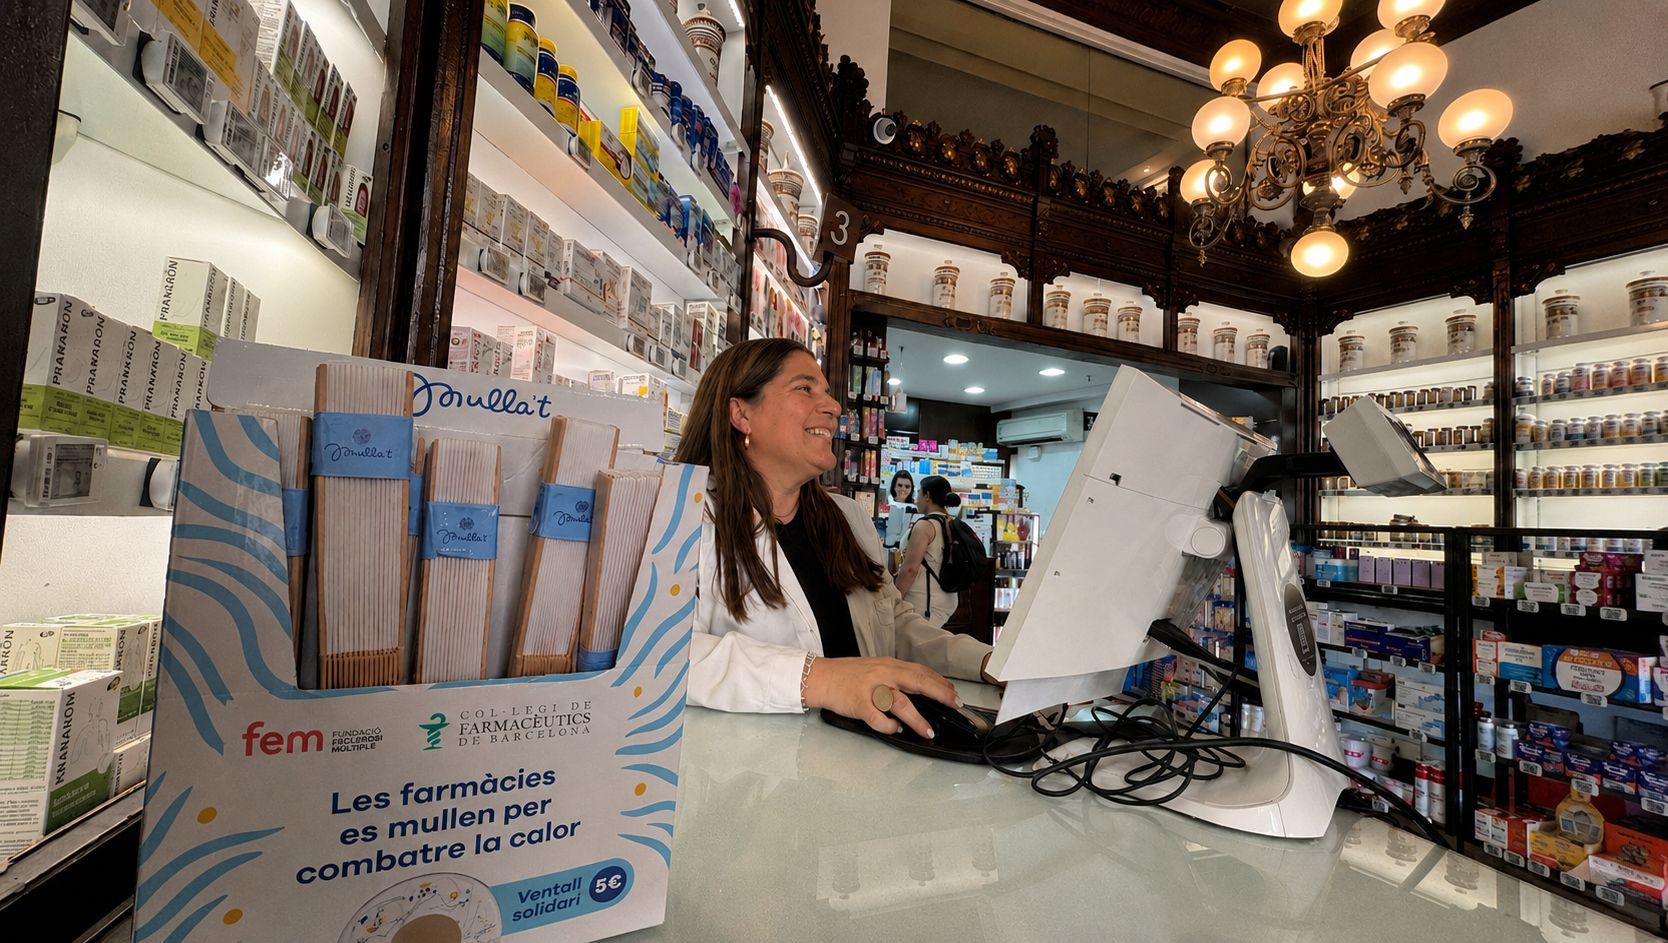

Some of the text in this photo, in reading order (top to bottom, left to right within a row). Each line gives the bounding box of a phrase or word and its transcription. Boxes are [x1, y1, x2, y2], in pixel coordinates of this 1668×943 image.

[830, 210, 850, 246] 3
[571, 700, 592, 711] DE
[242, 721, 323, 757] fem
[458, 712, 592, 736] FARMACÈUTICS
[458, 726, 591, 747] DE BARCELONA
[331, 768, 556, 815] Les farmàcies
[339, 796, 552, 846] es mullen per
[295, 818, 582, 885] combatre la calor
[517, 874, 622, 904] Ventall 5€
[511, 893, 581, 922] solidari
